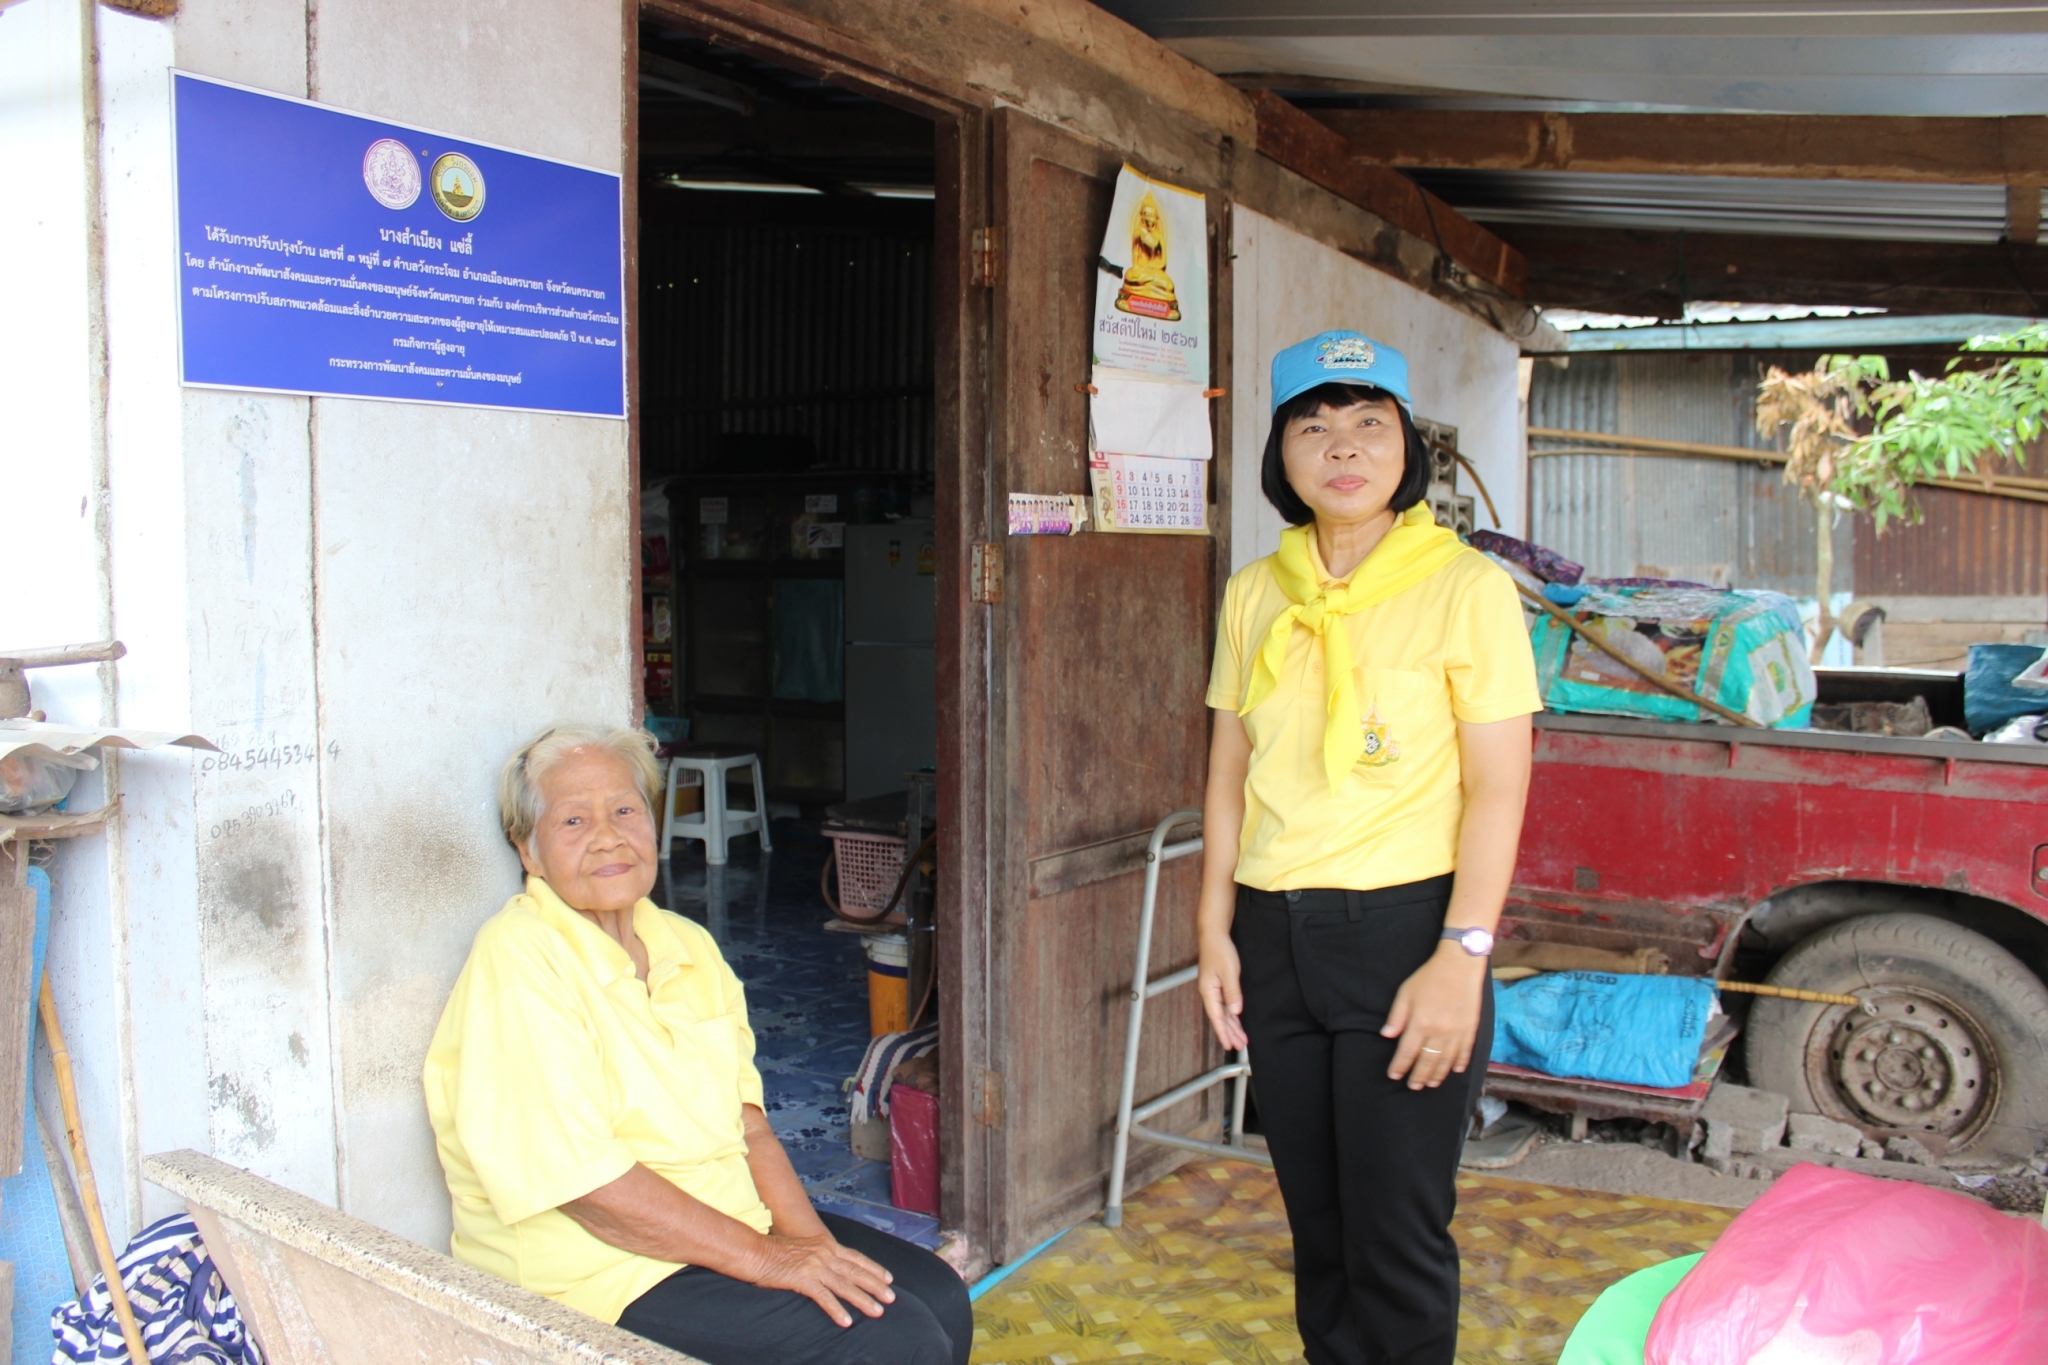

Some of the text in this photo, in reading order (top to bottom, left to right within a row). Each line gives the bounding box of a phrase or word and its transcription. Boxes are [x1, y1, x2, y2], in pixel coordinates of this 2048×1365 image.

[379, 227, 442, 250] นางสำเนียง
[205, 225, 606, 300] ได้รับการปรับปรุงบ้าน เลขที่ ๓ หมู่ที่ ๗ ตำบลวังกระโจม อำเภอเมืองนครนายก จังหวัดนครนายก
[184, 252, 205, 269] โดย
[477, 295, 503, 310] ร่วมกับ
[505, 299, 620, 325] องค์การบริหารส่วนตำบลวังกระโจม
[570, 330, 577, 343] ปี
[1099, 314, 1157, 342] สวัสดีปีใหม่
[1161, 328, 1198, 349] ๒๕๖๗
[392, 336, 466, 358] กรมกิจการผู้สูงอายุ
[329, 357, 522, 387] กระทรวงการพัฒนาสังคมและความมั่นคงของมนุษย์
[1115, 470, 1122, 481] 2
[1129, 471, 1134, 482] 3
[1142, 472, 1148, 482] 4
[1155, 473, 1160, 483] 5
[1167, 474, 1173, 484] 6
[1181, 475, 1187, 485] 7
[1116, 485, 1202, 500] 9 10 11 12 13 14 15
[1116, 499, 1203, 513] 16 17 18 19 20 21 22
[1130, 514, 1140, 524] 24
[1143, 514, 1152, 525] 25
[1155, 515, 1165, 525] 26
[1167, 515, 1177, 525] 27
[1180, 516, 1190, 526] 28
